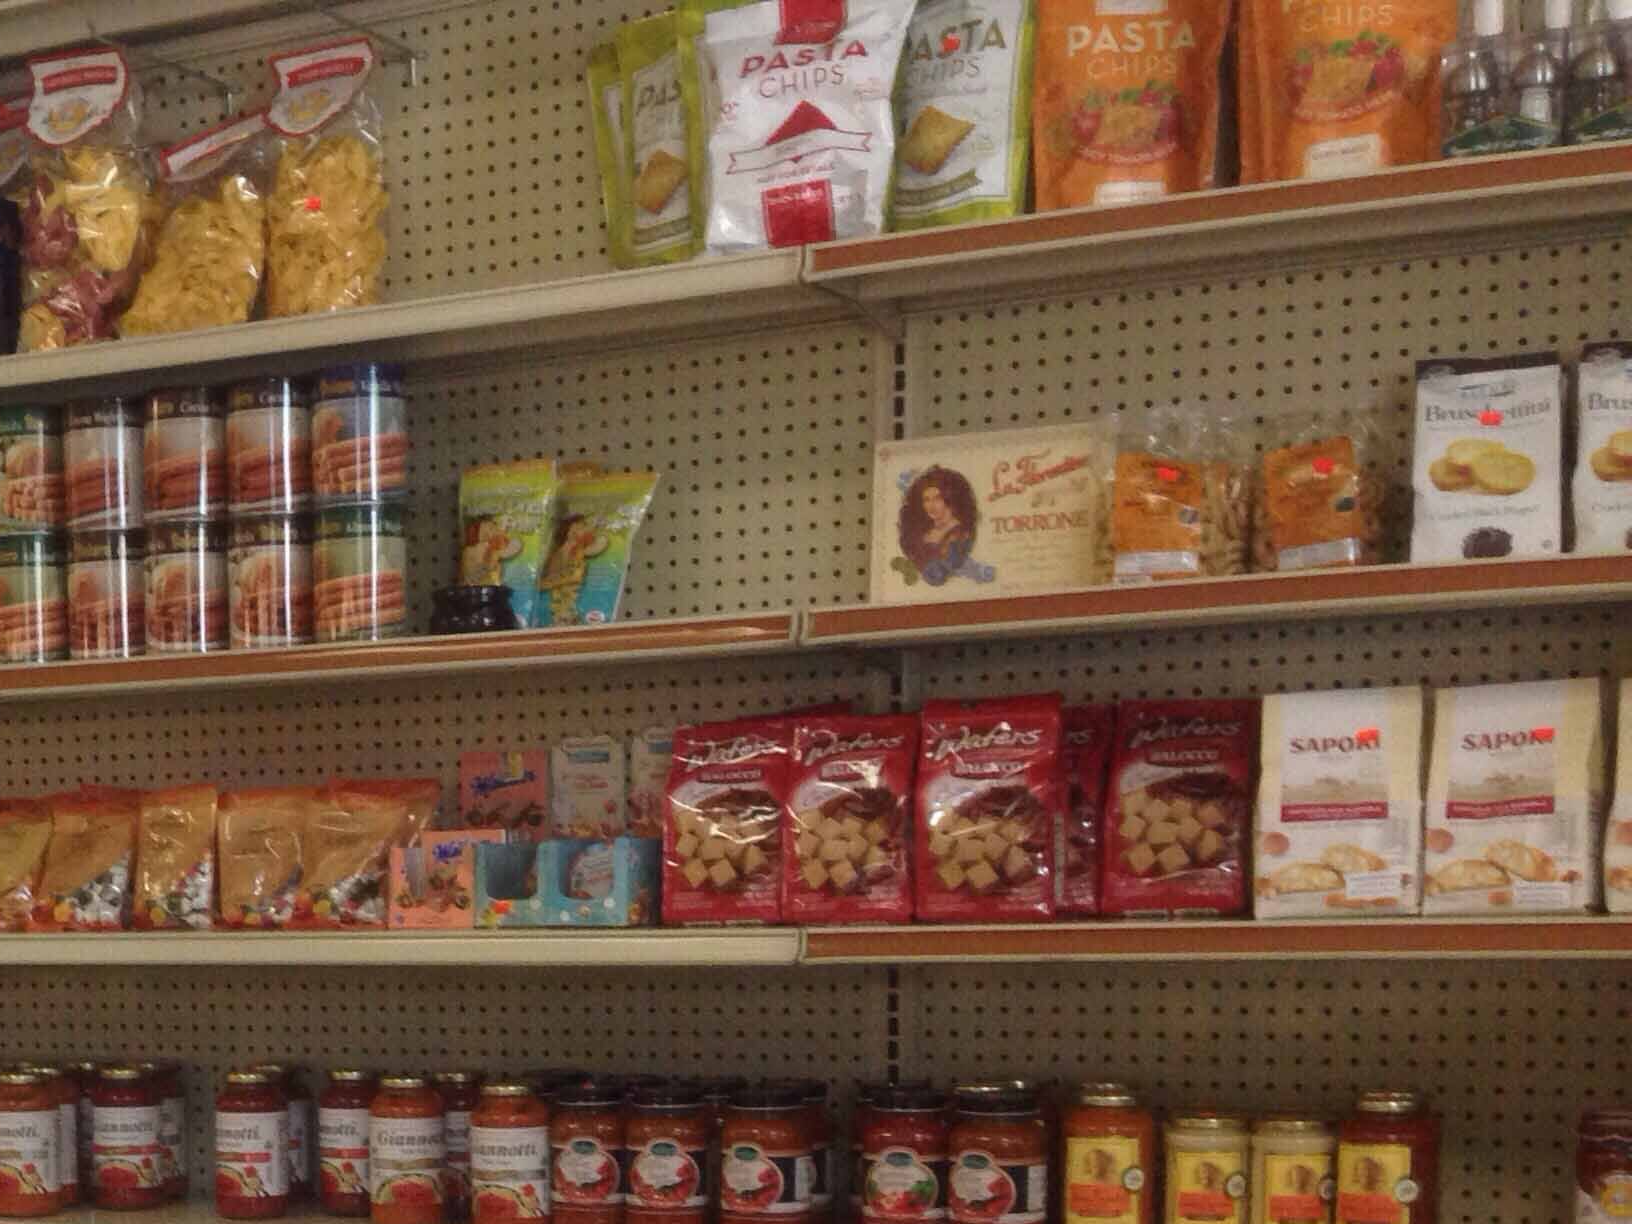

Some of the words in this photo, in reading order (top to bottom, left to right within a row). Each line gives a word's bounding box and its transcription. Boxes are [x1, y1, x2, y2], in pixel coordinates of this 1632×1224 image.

[1299, 3, 1394, 33] CHIPS
[1067, 19, 1196, 56] PASTA
[738, 39, 868, 78] PASTA
[1086, 52, 1180, 80] CHIPS
[759, 63, 846, 98] CHIPS
[1424, 397, 1552, 424] Brusttini
[990, 510, 1090, 536] TORRONE
[934, 720, 1043, 761] Wafers
[1129, 716, 1243, 749] Wafers
[1462, 730, 1552, 751] SAPOR
[376, 1128, 445, 1149] Gianno
